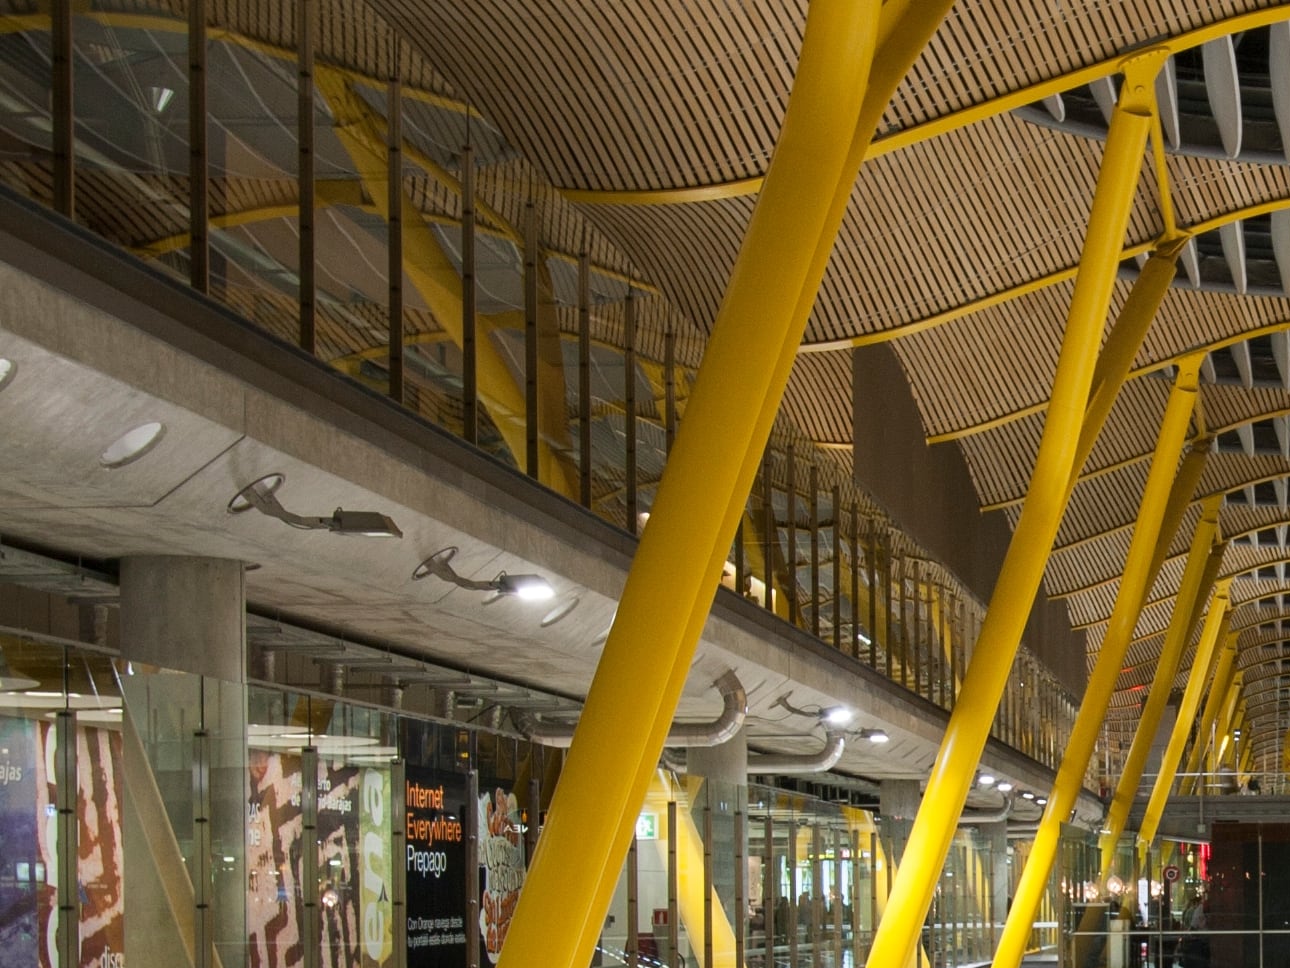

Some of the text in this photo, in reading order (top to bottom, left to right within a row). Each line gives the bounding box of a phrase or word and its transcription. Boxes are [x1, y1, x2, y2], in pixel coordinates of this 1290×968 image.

[406, 780, 444, 810] Internet
[407, 813, 462, 847] Everywhere
[407, 844, 447, 878] Prepago
